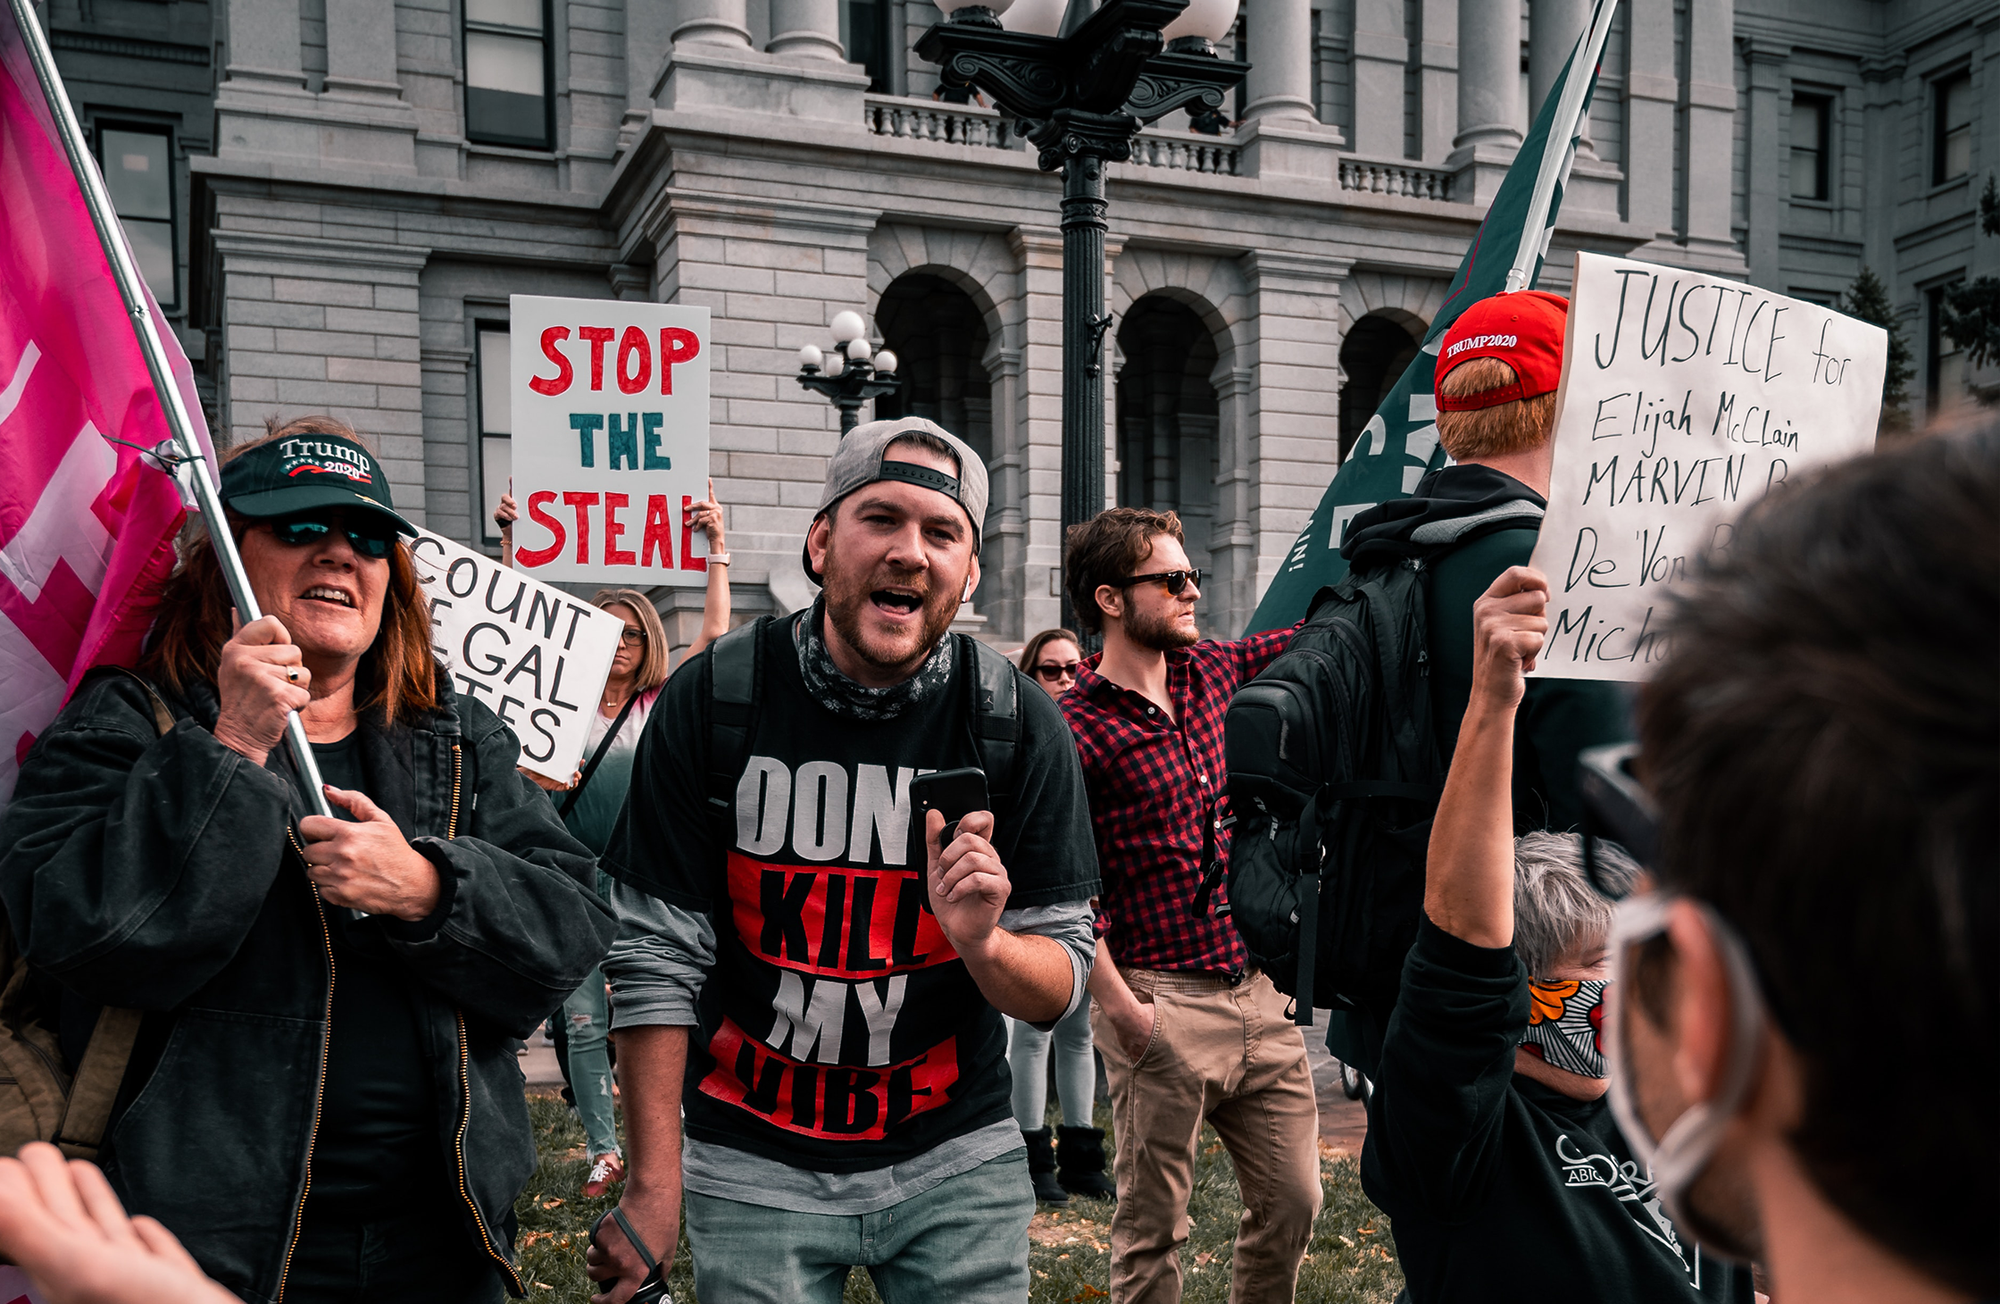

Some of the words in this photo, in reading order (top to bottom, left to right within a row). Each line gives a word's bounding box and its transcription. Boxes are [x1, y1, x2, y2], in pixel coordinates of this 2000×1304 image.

[528, 326, 700, 396] STOP
[1446, 334, 1518, 359] TRUMP2020
[1594, 269, 1790, 383] JUSTICE
[1812, 318, 1851, 386] for
[279, 438, 370, 476] Trump
[569, 412, 672, 471] THE
[1592, 389, 1692, 459] Elijah
[324, 461, 360, 480] 2020
[1582, 453, 1746, 507] MARVIN
[514, 490, 707, 572] STEAL
[409, 536, 592, 651] COUNT
[430, 597, 579, 713] EGAL
[1544, 604, 1675, 663] Micha
[455, 672, 562, 764] TES
[736, 755, 938, 866] DON
[759, 868, 931, 971] KILL
[765, 969, 908, 1067] MY
